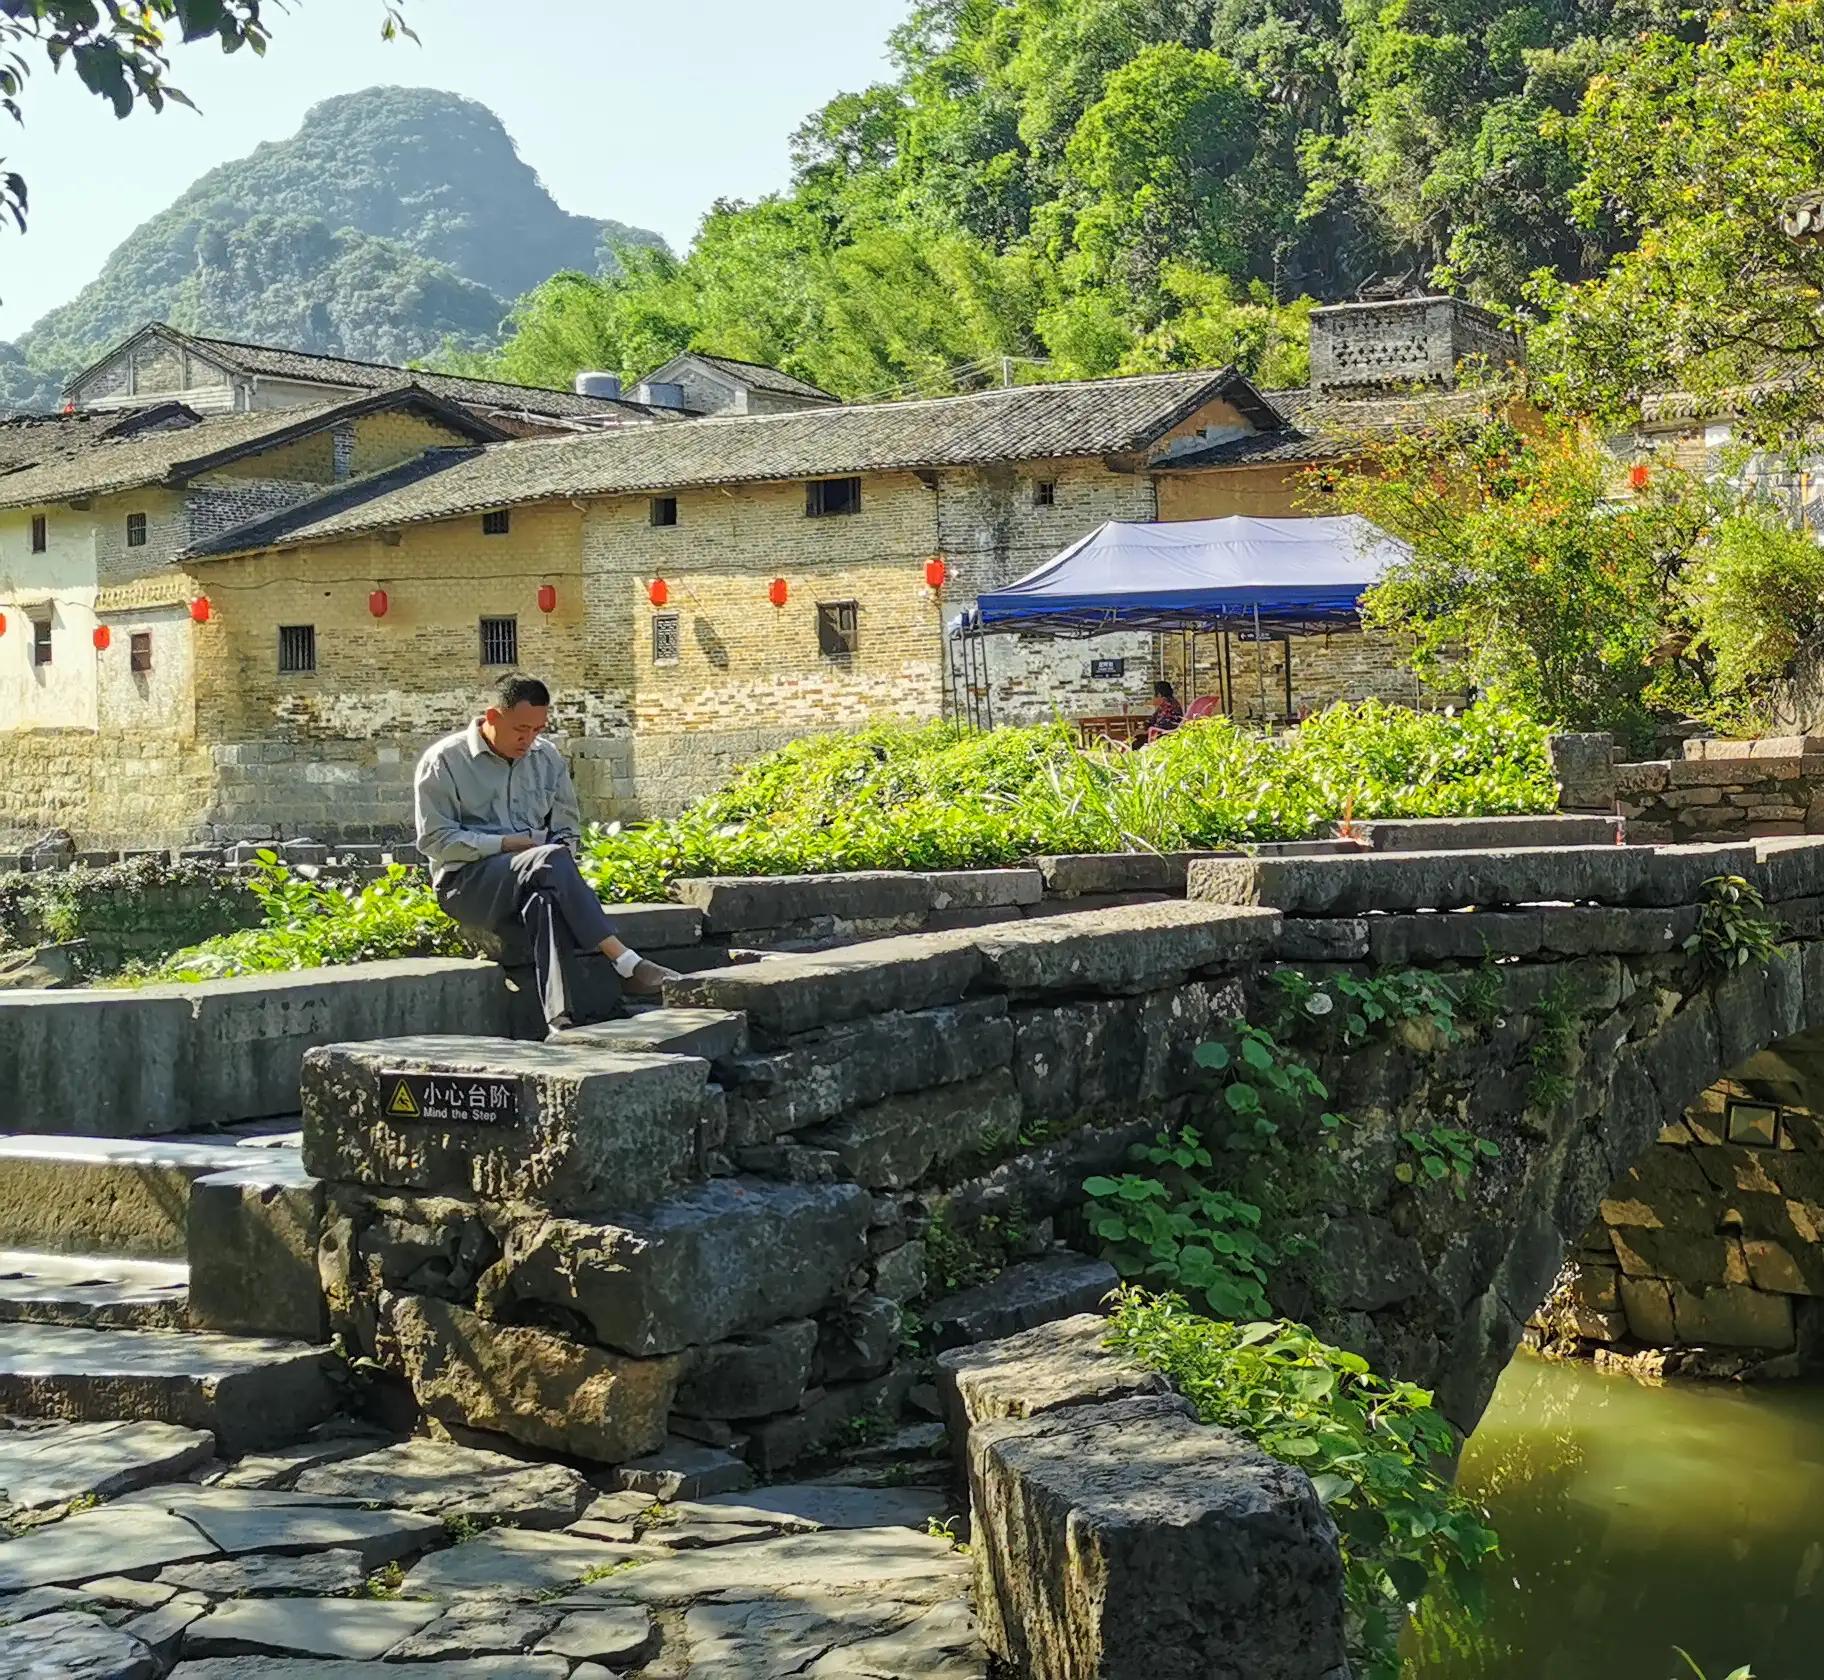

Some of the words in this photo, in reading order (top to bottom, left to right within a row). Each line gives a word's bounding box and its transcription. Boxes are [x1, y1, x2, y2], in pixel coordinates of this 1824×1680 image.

[424, 1081, 510, 1108] 小心台阶
[424, 1107, 448, 1119] Mind
[452, 1108, 468, 1120] the
[472, 1109, 497, 1122] Step
